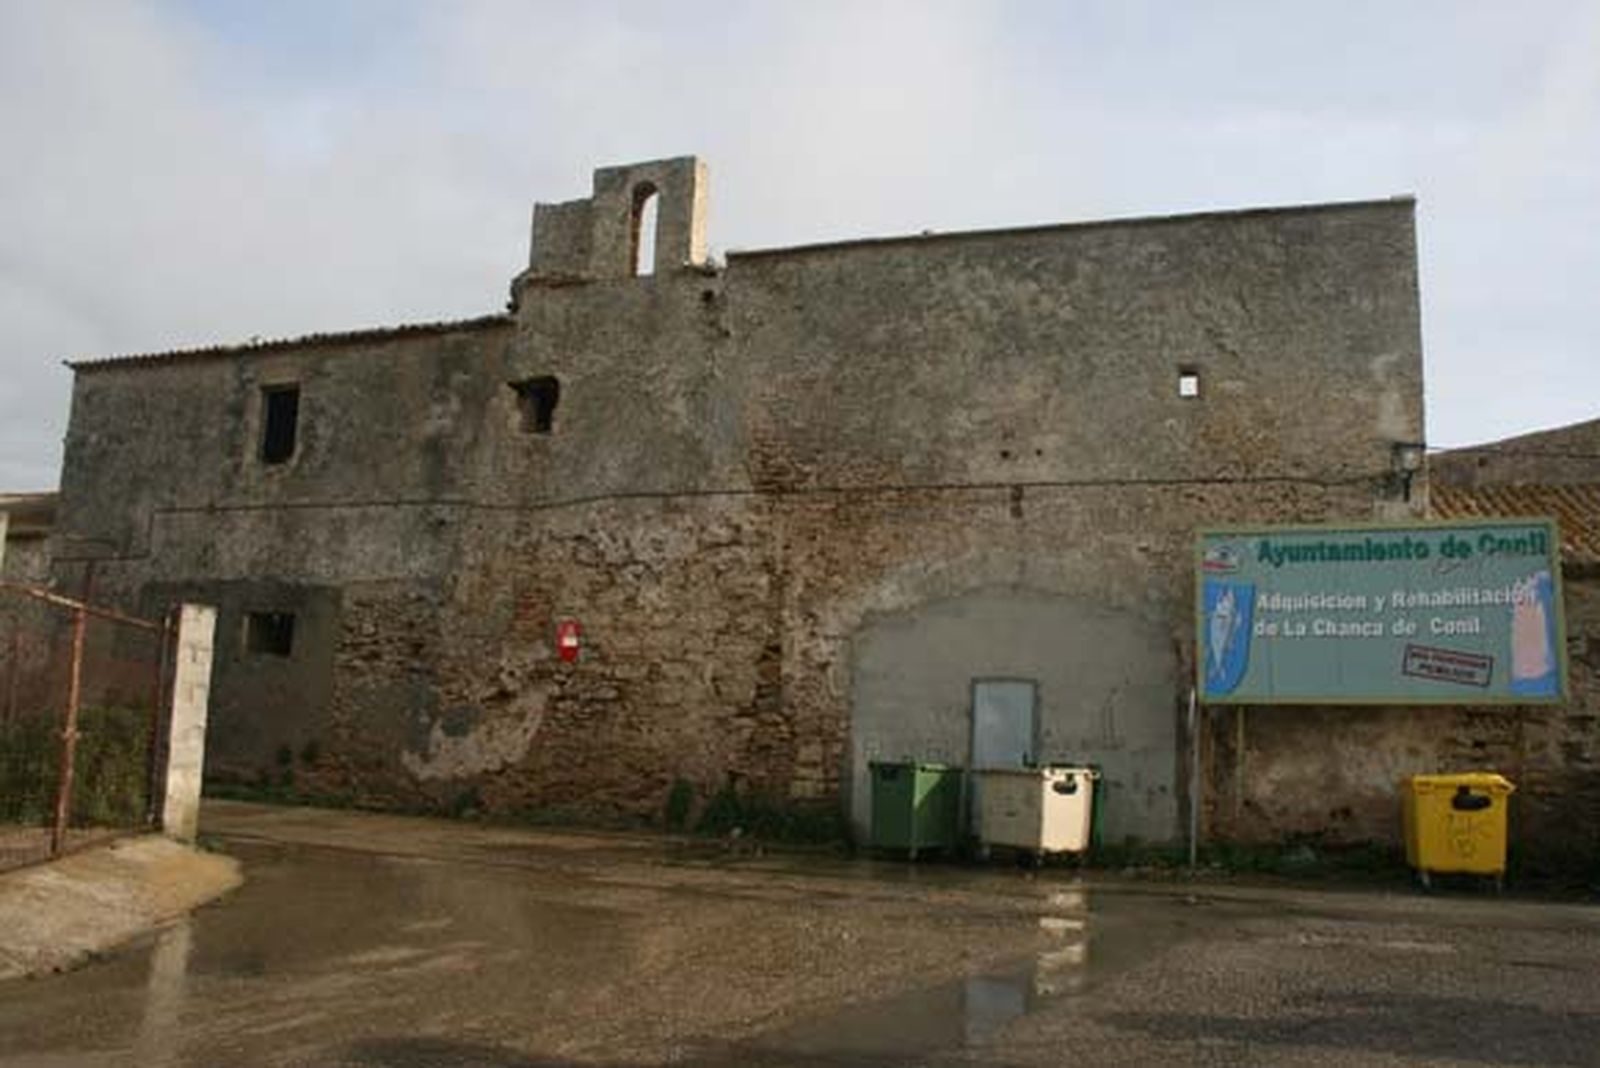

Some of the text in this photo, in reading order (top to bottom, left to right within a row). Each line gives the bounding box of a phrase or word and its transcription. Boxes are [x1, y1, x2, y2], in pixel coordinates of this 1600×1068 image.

[1257, 537, 1429, 567] Ayuntamiento
[1440, 535, 1472, 559] de
[1479, 531, 1547, 557] Conil
[1374, 594, 1386, 613] y
[1255, 617, 1481, 637] de La Chanca de Conil
